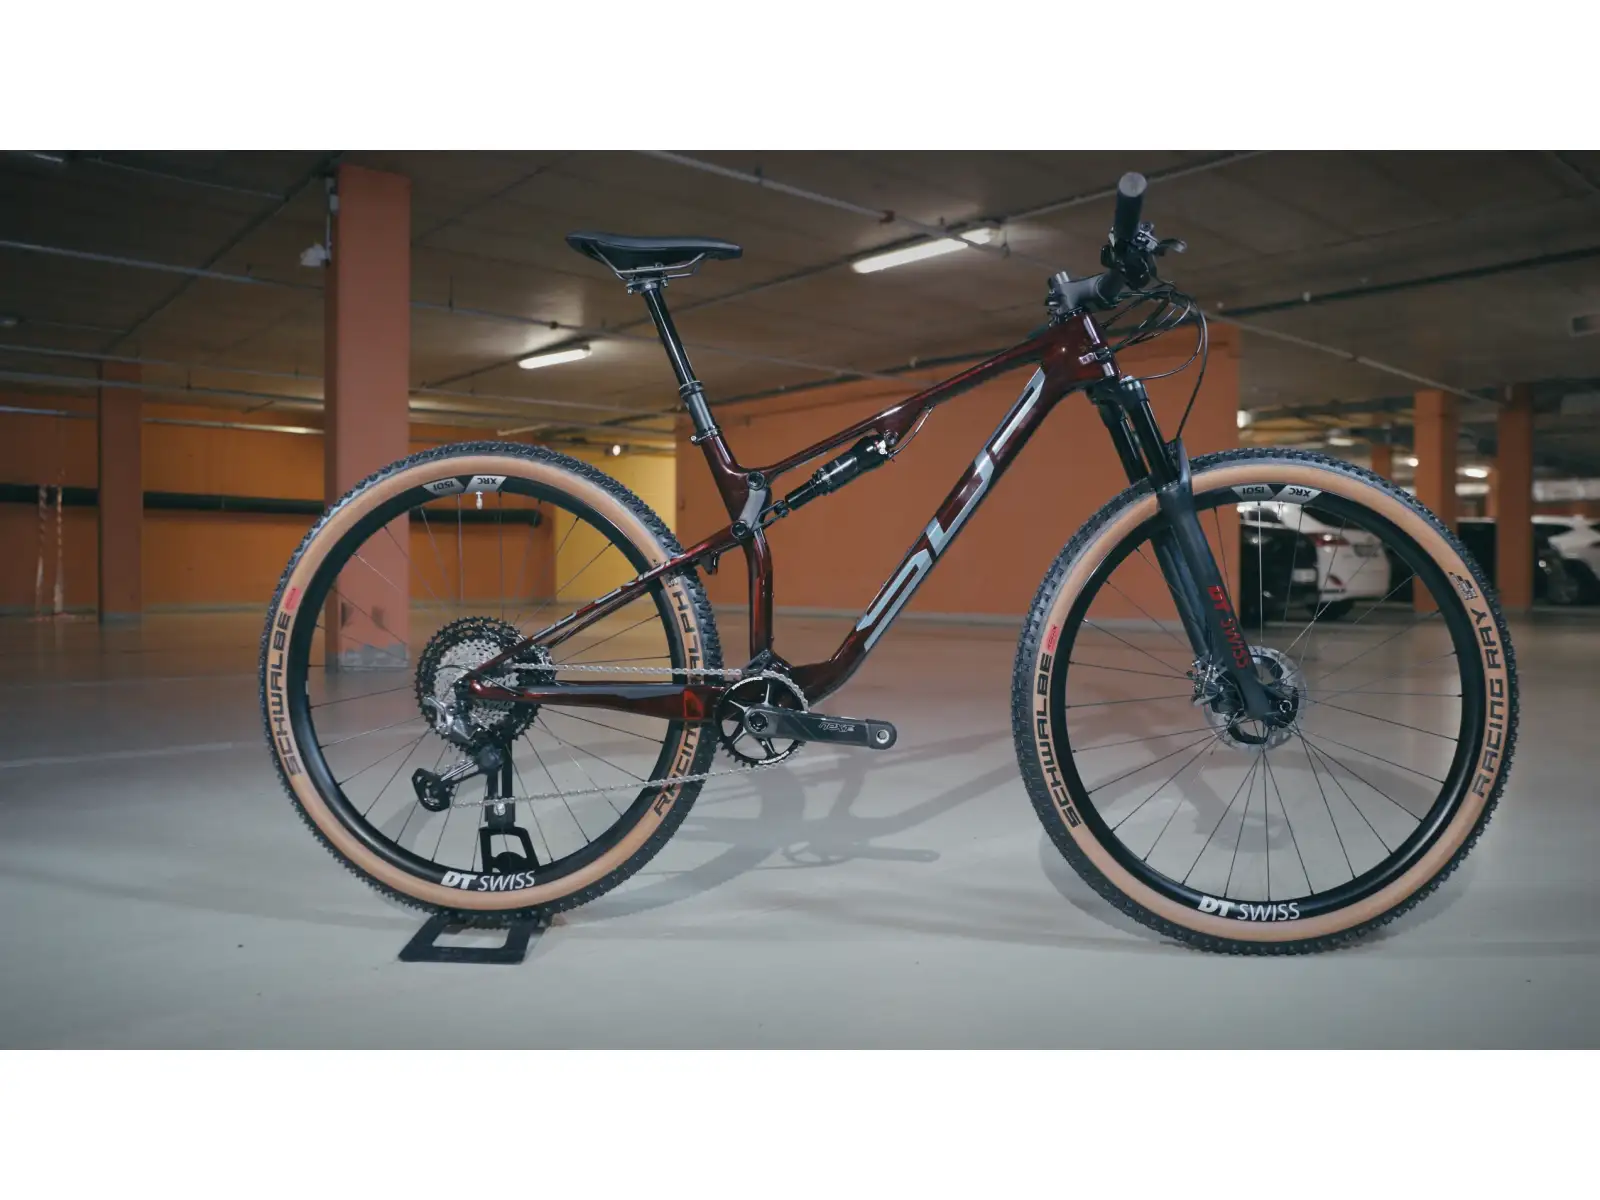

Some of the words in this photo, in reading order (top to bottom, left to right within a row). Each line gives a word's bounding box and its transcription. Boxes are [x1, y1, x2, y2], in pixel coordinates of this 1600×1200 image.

[477, 477, 497, 485] XRC
[1289, 487, 1311, 498] XRC
[672, 592, 703, 682] ALPH
[1209, 585, 1232, 615] DT
[1222, 617, 1251, 669] SWISS
[1470, 607, 1502, 670] RAY
[270, 610, 304, 777] SCHWALBE
[653, 727, 699, 817] RACIN
[1035, 652, 1081, 829] SCHWALBE
[1472, 678, 1505, 799] RACING
[441, 871, 478, 889] DT
[478, 870, 536, 892] SWISS
[1197, 896, 1237, 916] DT
[1238, 902, 1300, 922] SWISS
